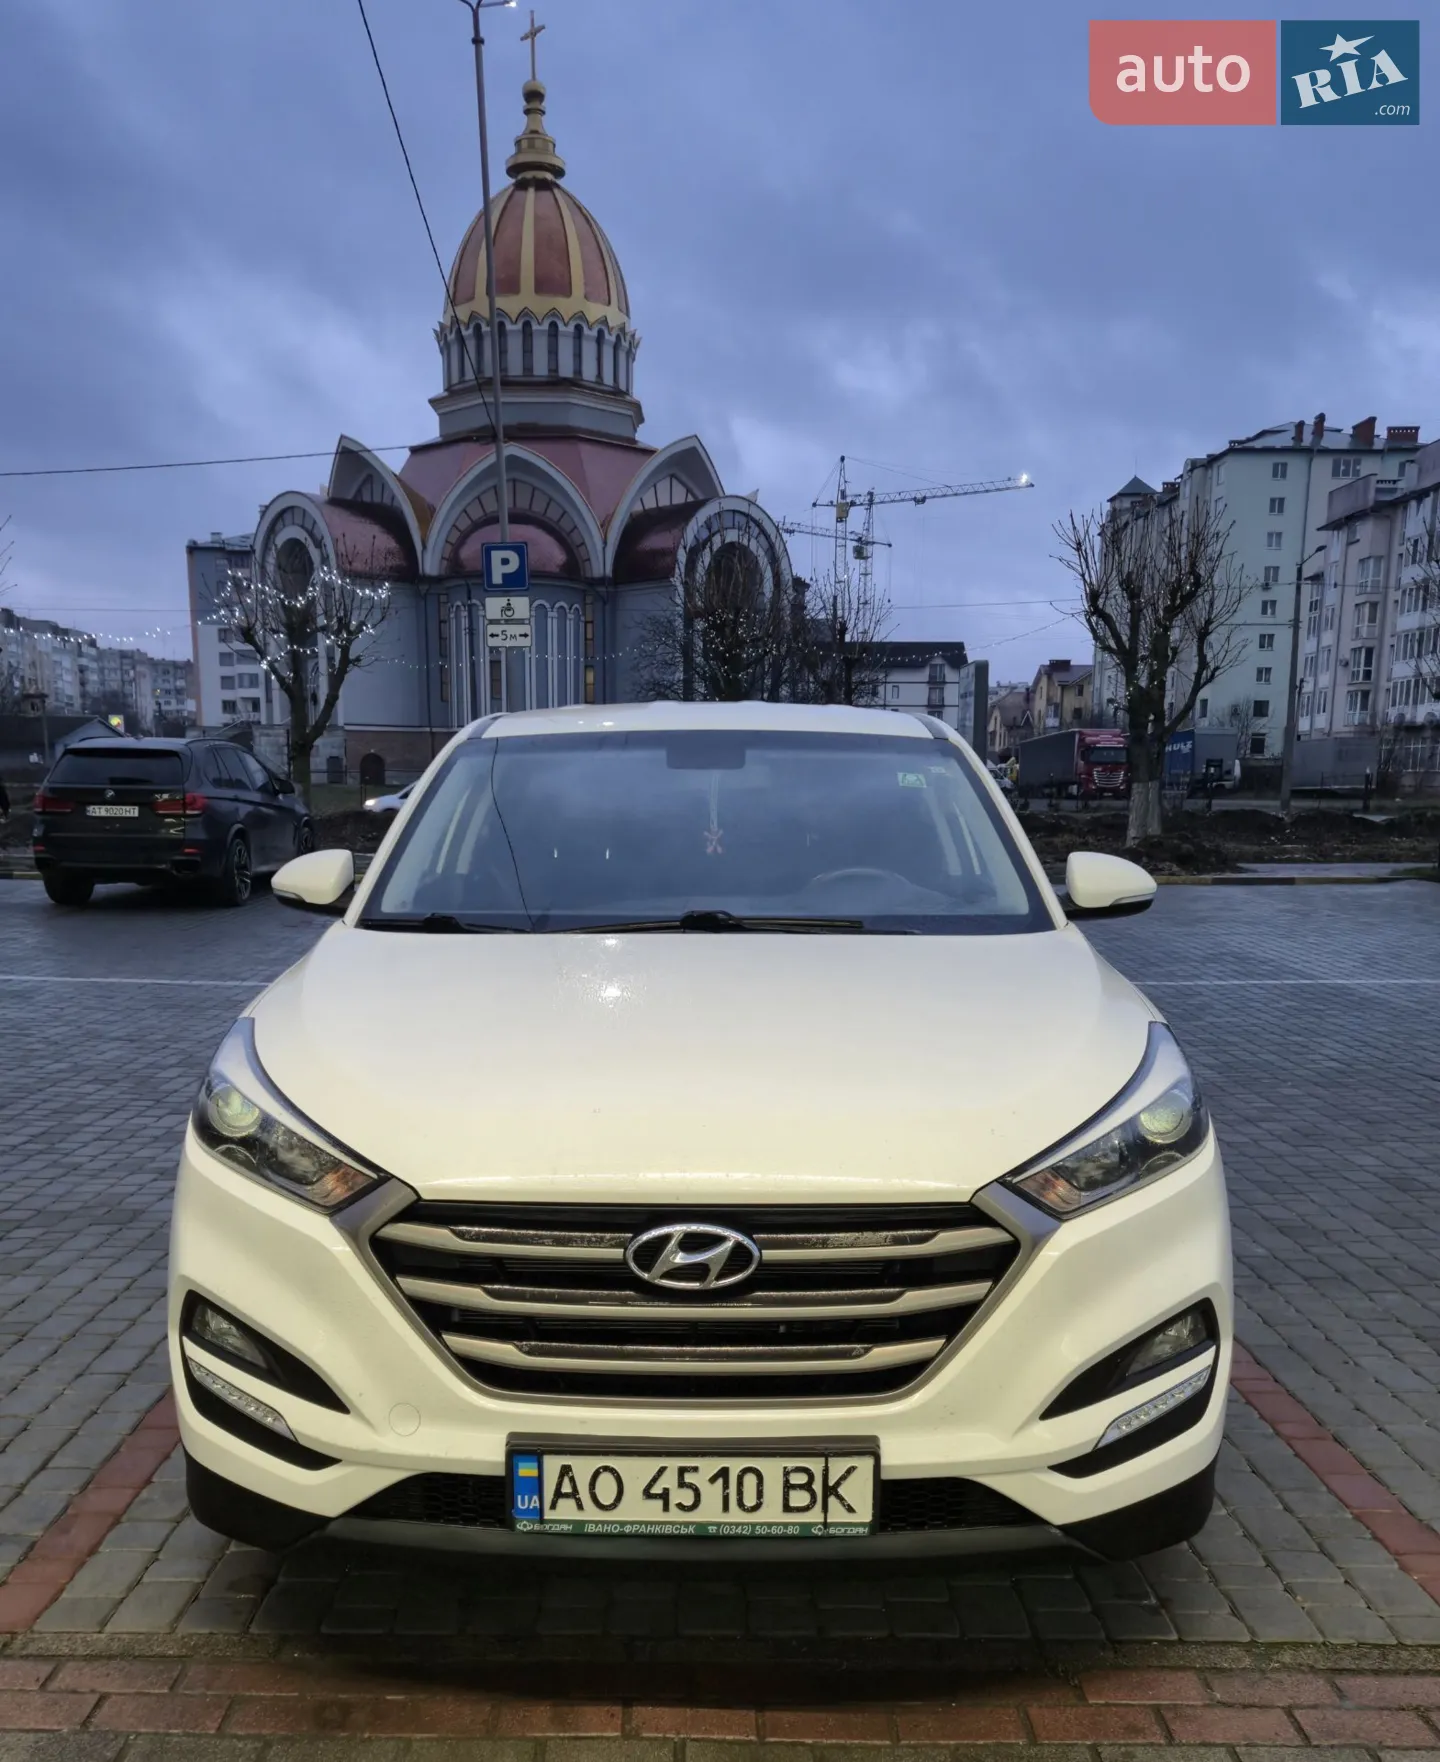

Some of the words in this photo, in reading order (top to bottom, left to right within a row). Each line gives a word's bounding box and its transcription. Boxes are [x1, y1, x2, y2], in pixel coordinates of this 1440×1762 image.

[490, 550, 520, 585] P
[549, 1464, 625, 1511] AO
[642, 1465, 764, 1513] 4510
[782, 1465, 859, 1513] BK
[517, 1495, 540, 1509] UA
[584, 1523, 696, 1534] ІВАНО-ФРАНКІВСЬК
[719, 1524, 751, 1535] (0342)
[754, 1525, 800, 1535] 50-60-80
